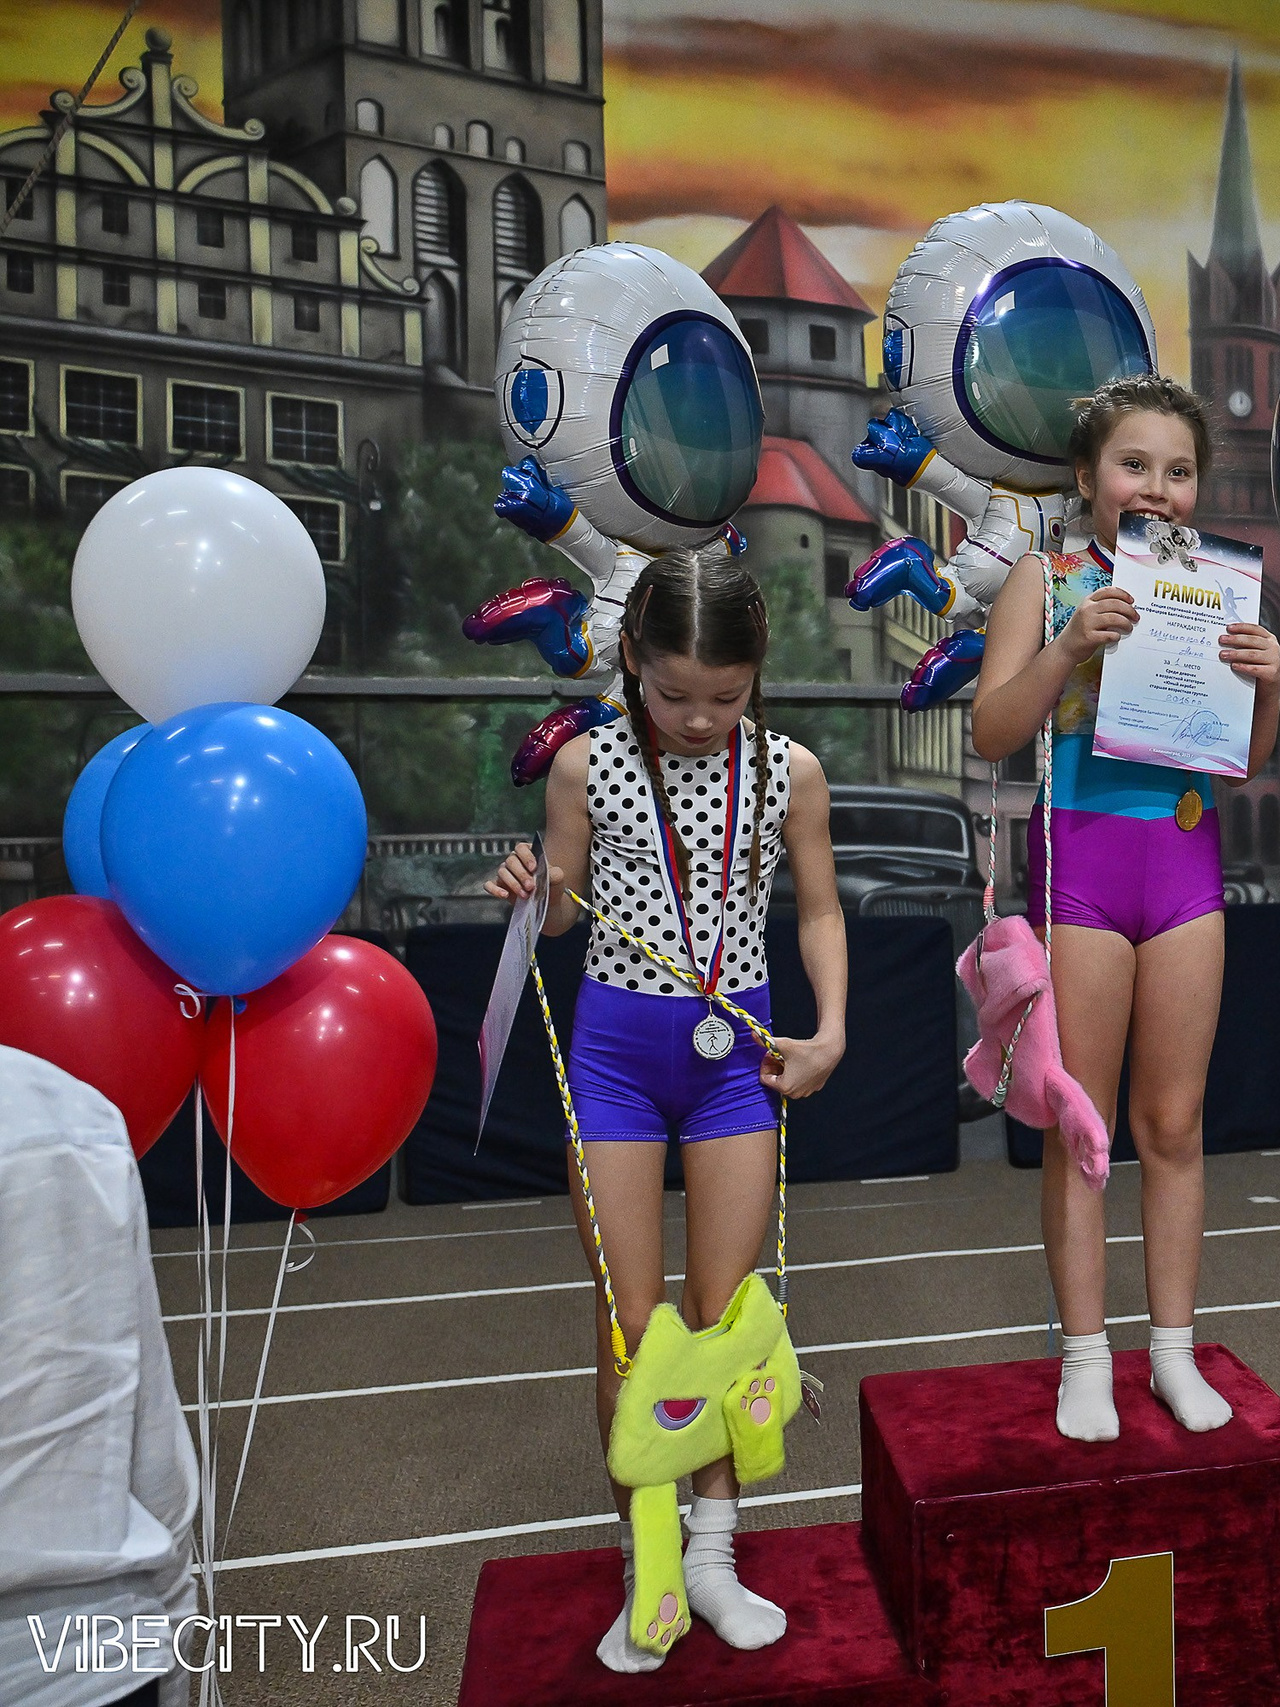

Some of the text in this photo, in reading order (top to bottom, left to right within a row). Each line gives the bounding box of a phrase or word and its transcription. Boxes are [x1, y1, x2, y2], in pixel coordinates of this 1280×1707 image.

[1154, 579, 1221, 611] ГРАМОТА
[1166, 620, 1207, 633] НАГРАЖДАЕТСЯ
[1183, 663, 1201, 671] место
[1044, 1551, 1175, 1707] 1
